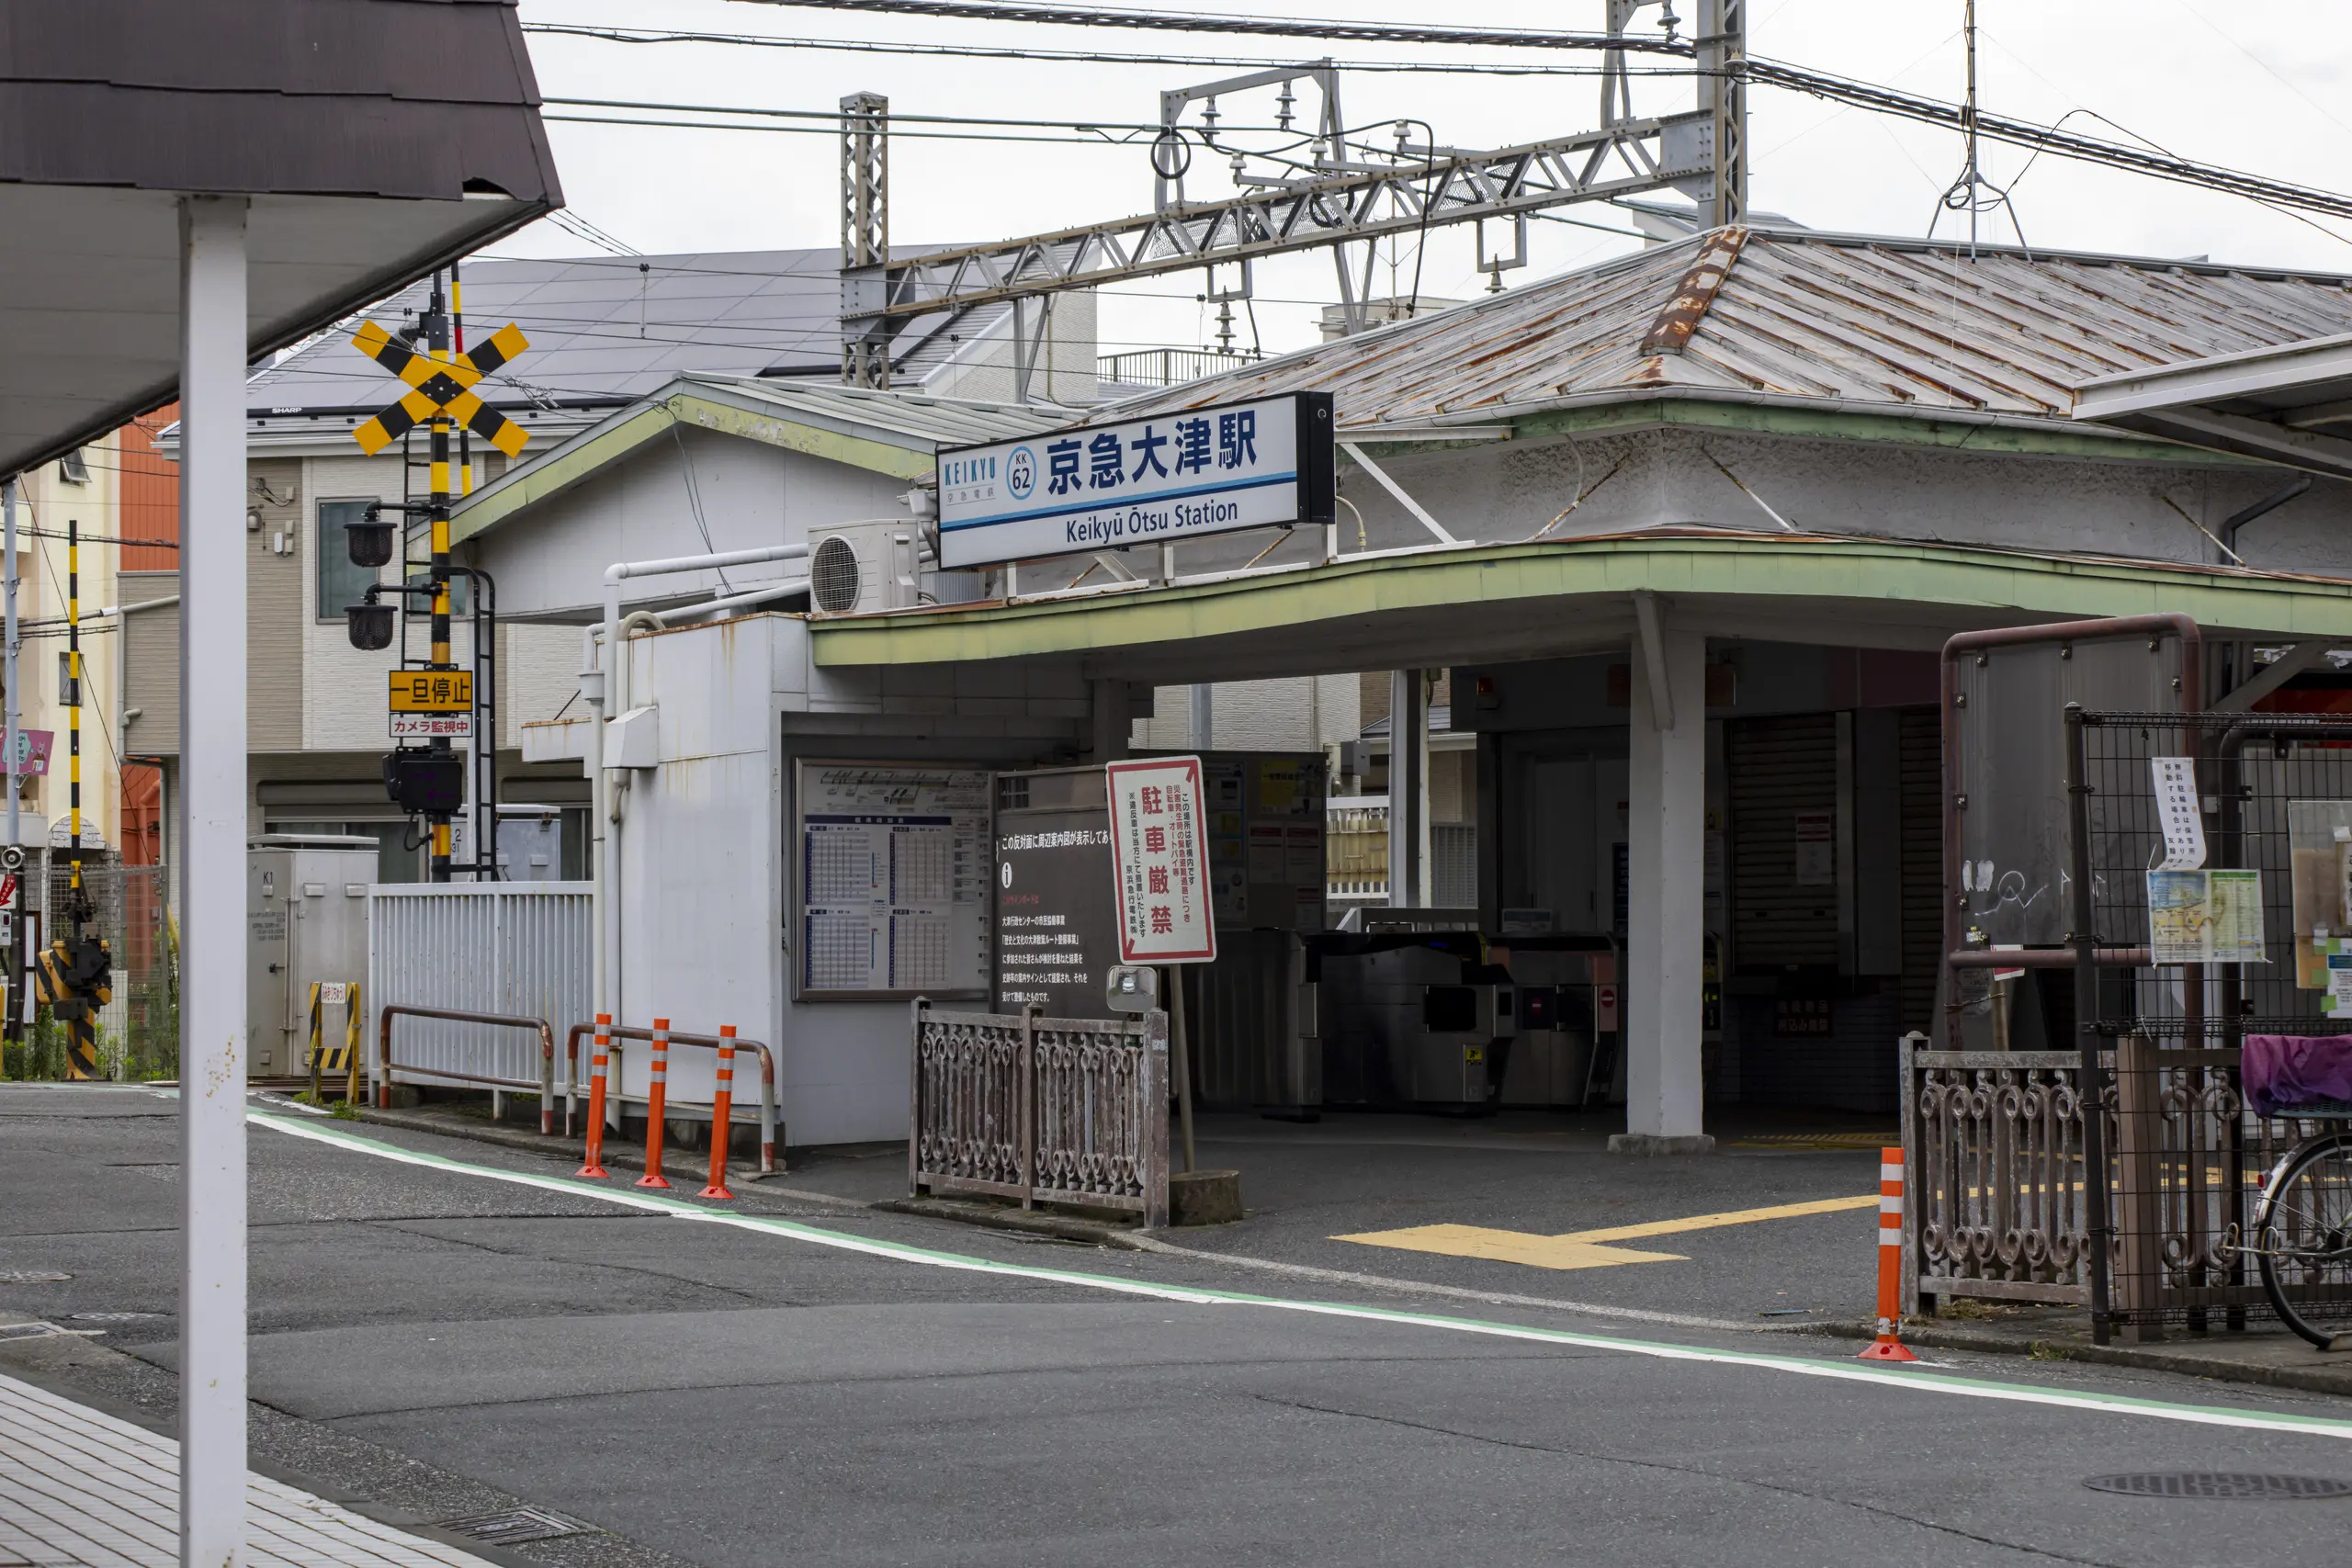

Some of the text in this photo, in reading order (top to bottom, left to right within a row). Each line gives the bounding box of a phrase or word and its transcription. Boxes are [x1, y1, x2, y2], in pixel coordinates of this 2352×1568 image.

[1015, 454, 1027, 465] KK
[1046, 410, 1257, 495] 京急大津駅
[944, 457, 995, 486] KEIKYU
[1012, 468, 1030, 490] 62
[947, 487, 994, 503] 京急電鉄
[1067, 499, 1238, 544] Keikyū Ōtsu Station
[390, 677, 470, 704] 一旦停止
[394, 720, 469, 733] カメラ監視中
[1166, 785, 1180, 876] 自転車・オートバイ等
[1182, 794, 1194, 885] この場所は駅構内です
[1142, 786, 1172, 934] 駐車厳禁
[1174, 784, 1191, 923] 災害発生時の緊急避難通路につき
[263, 871, 273, 885] K1
